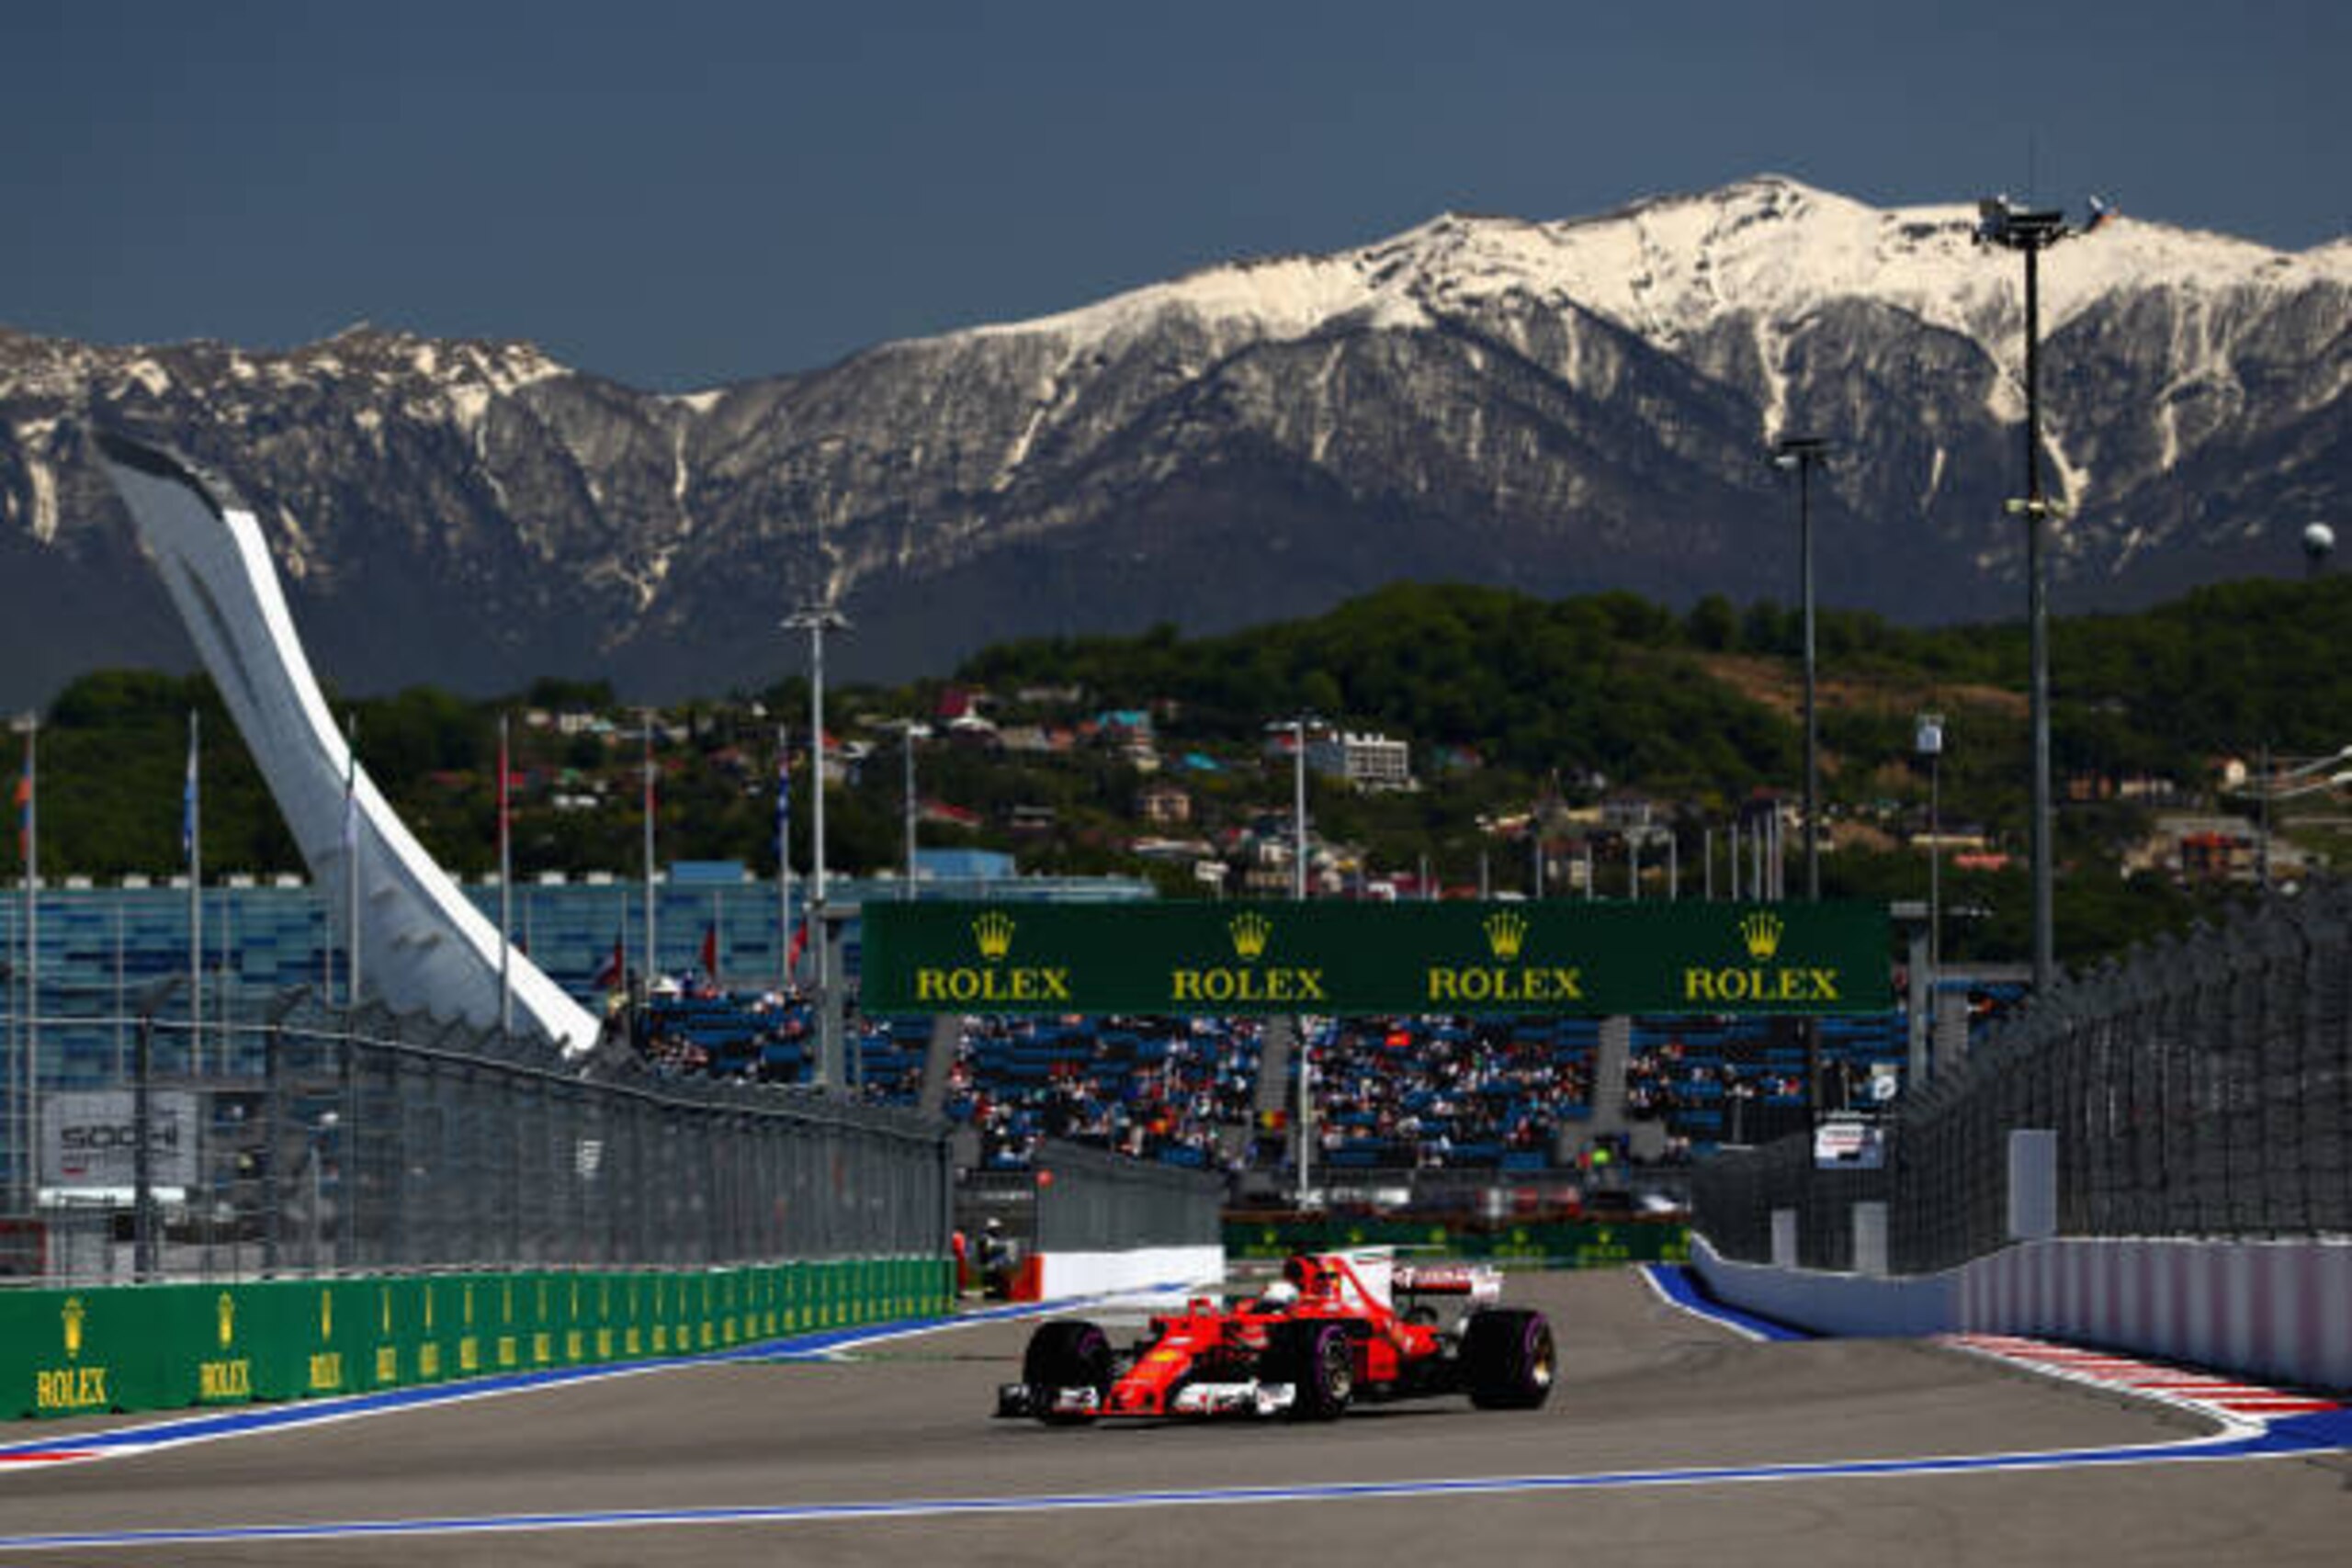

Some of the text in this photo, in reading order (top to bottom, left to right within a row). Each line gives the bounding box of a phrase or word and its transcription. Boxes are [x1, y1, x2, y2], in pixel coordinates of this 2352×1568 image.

[918, 967, 1070, 1001] ROLEX
[1172, 967, 1325, 1001] ROLEX
[1428, 967, 1582, 1001] ROLEX
[1685, 967, 1838, 1001] ROLEX
[38, 1367, 107, 1408] ROLEX
